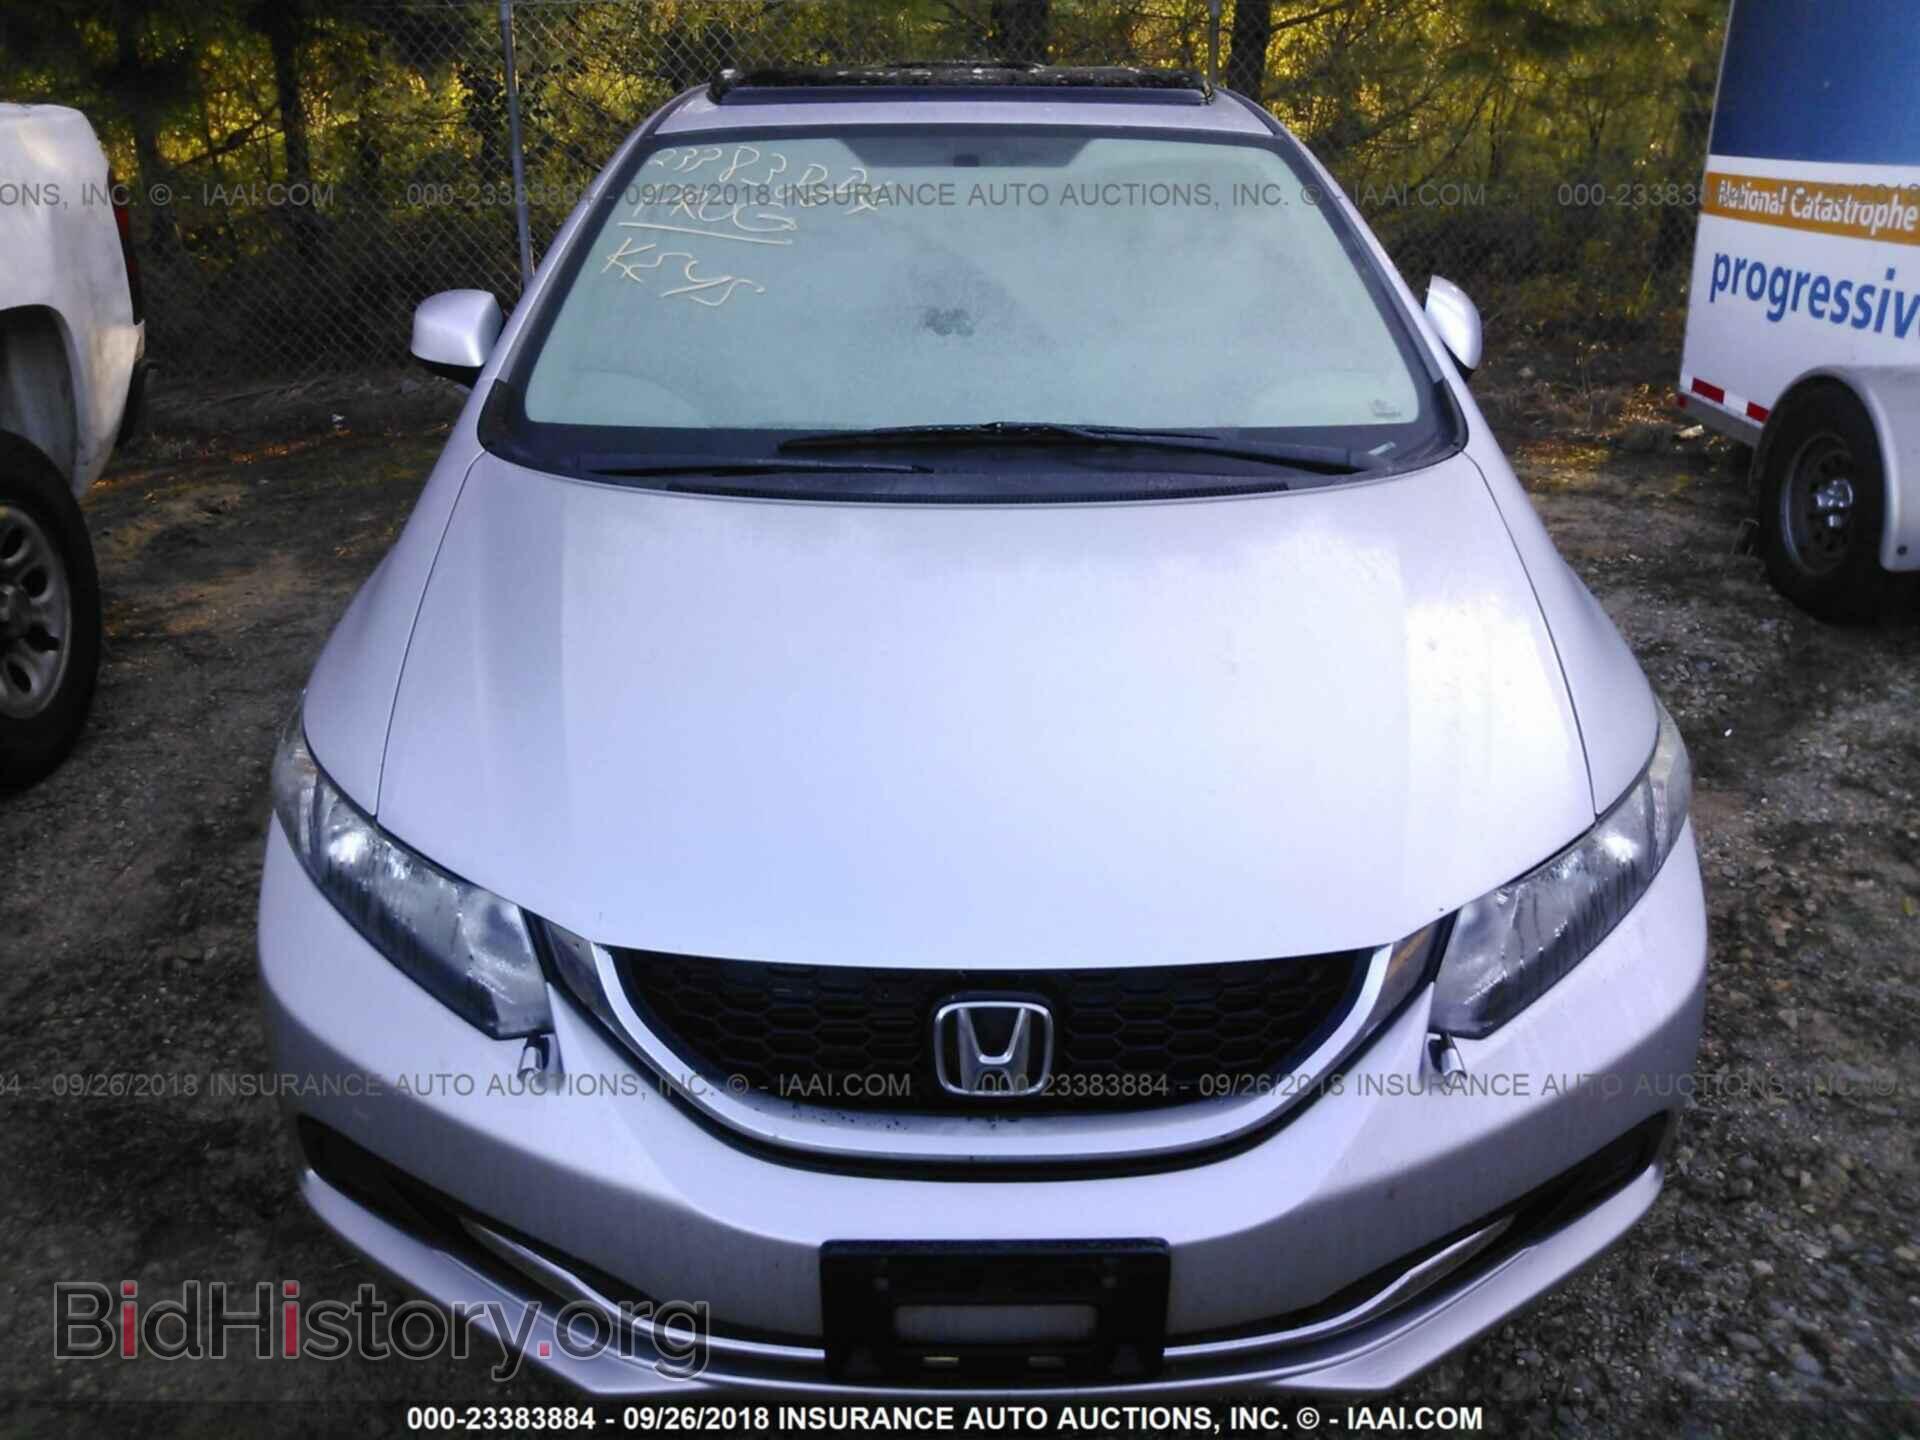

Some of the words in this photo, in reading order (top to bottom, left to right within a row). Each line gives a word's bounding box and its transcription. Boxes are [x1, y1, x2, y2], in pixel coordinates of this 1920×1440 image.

[1719, 179, 1788, 216] National
[1791, 187, 1919, 236] Catastrophe
[1709, 252, 1920, 339] progressiv
